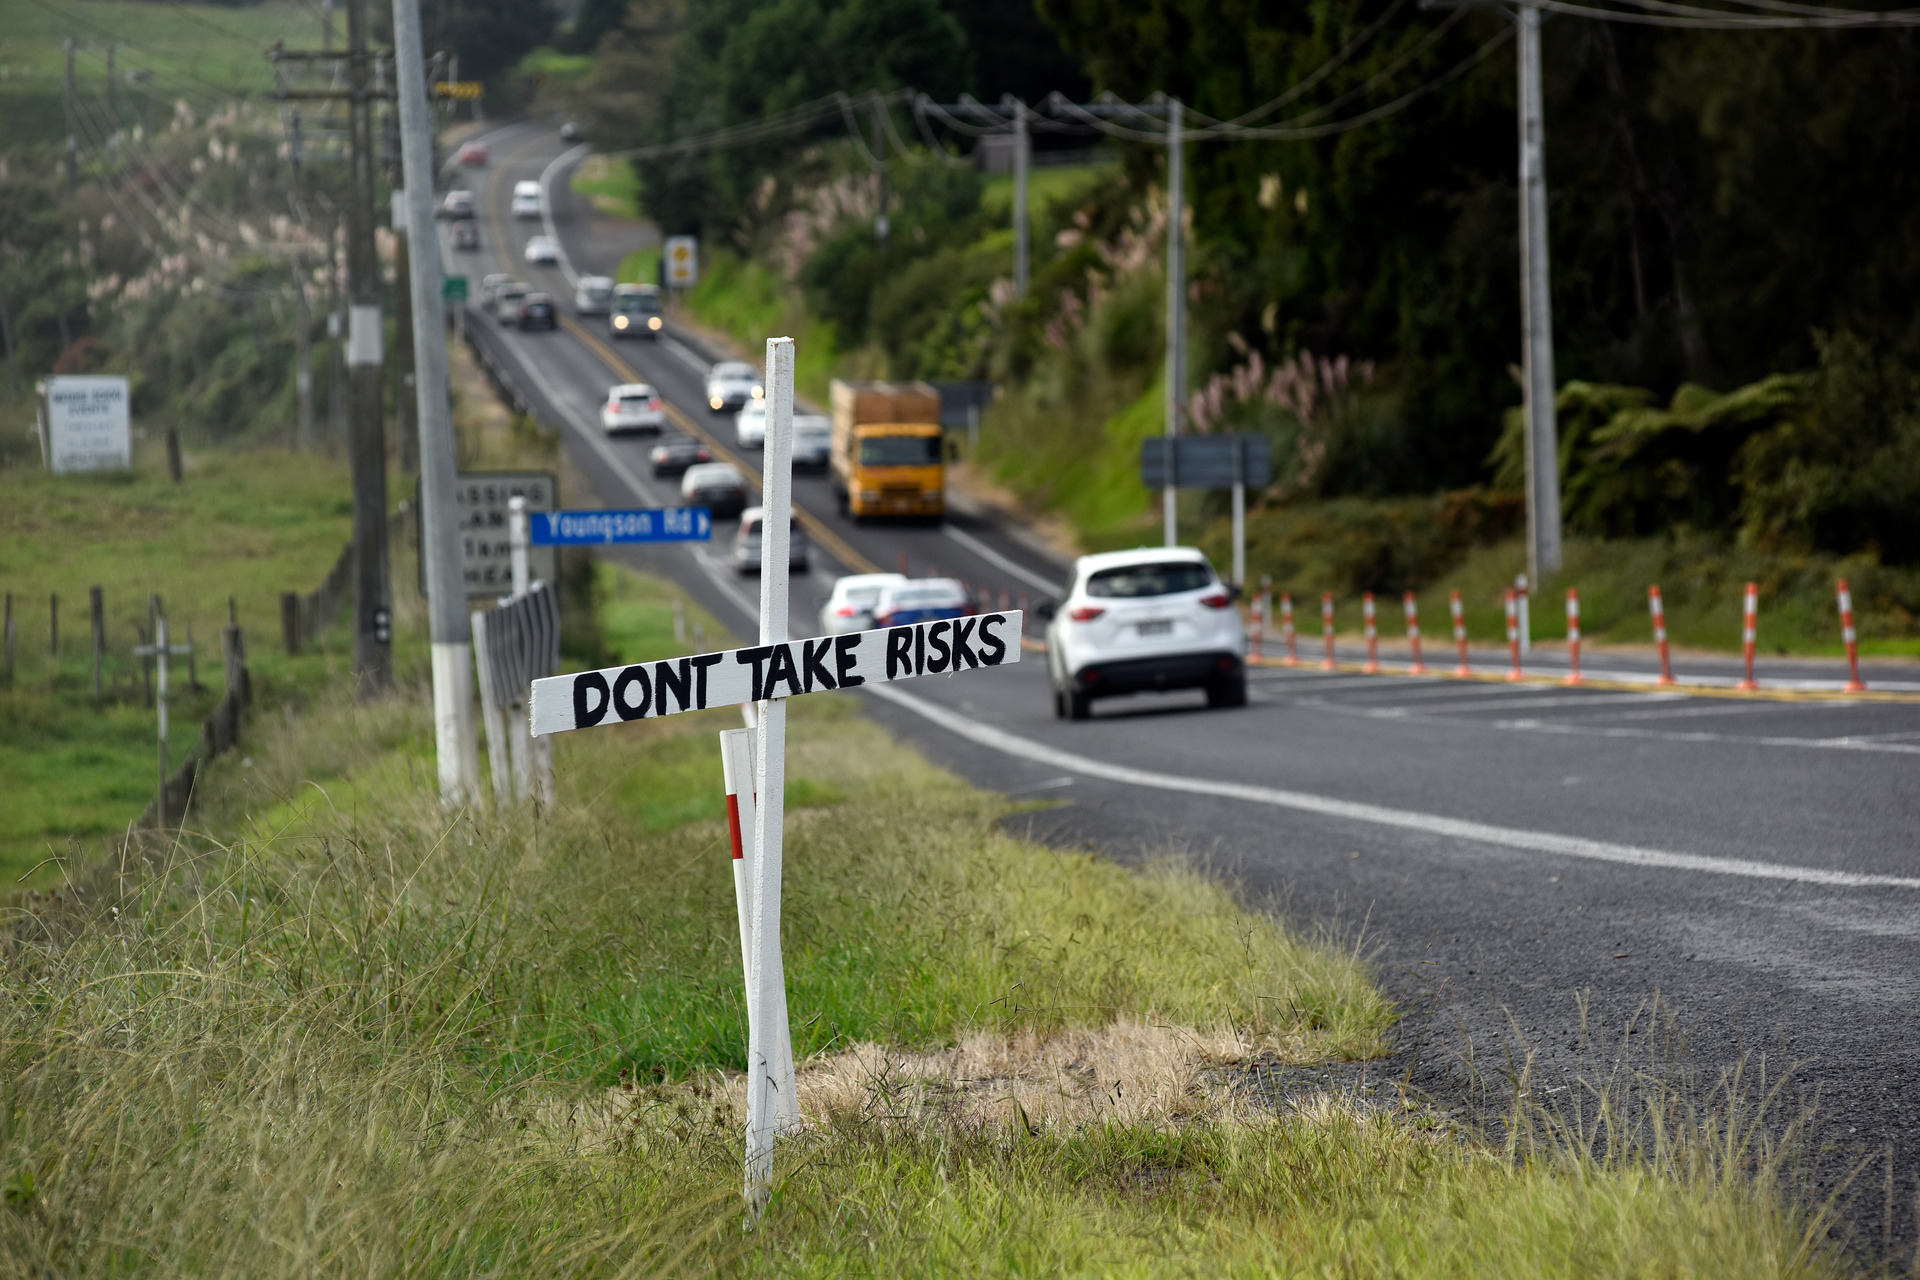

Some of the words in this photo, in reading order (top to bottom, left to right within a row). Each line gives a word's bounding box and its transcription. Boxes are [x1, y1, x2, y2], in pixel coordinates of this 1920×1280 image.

[546, 509, 653, 543] Youngson
[662, 507, 692, 533] Rd
[573, 653, 723, 729] DONT
[736, 633, 866, 702] TAKE
[886, 614, 1007, 680] RISKS
